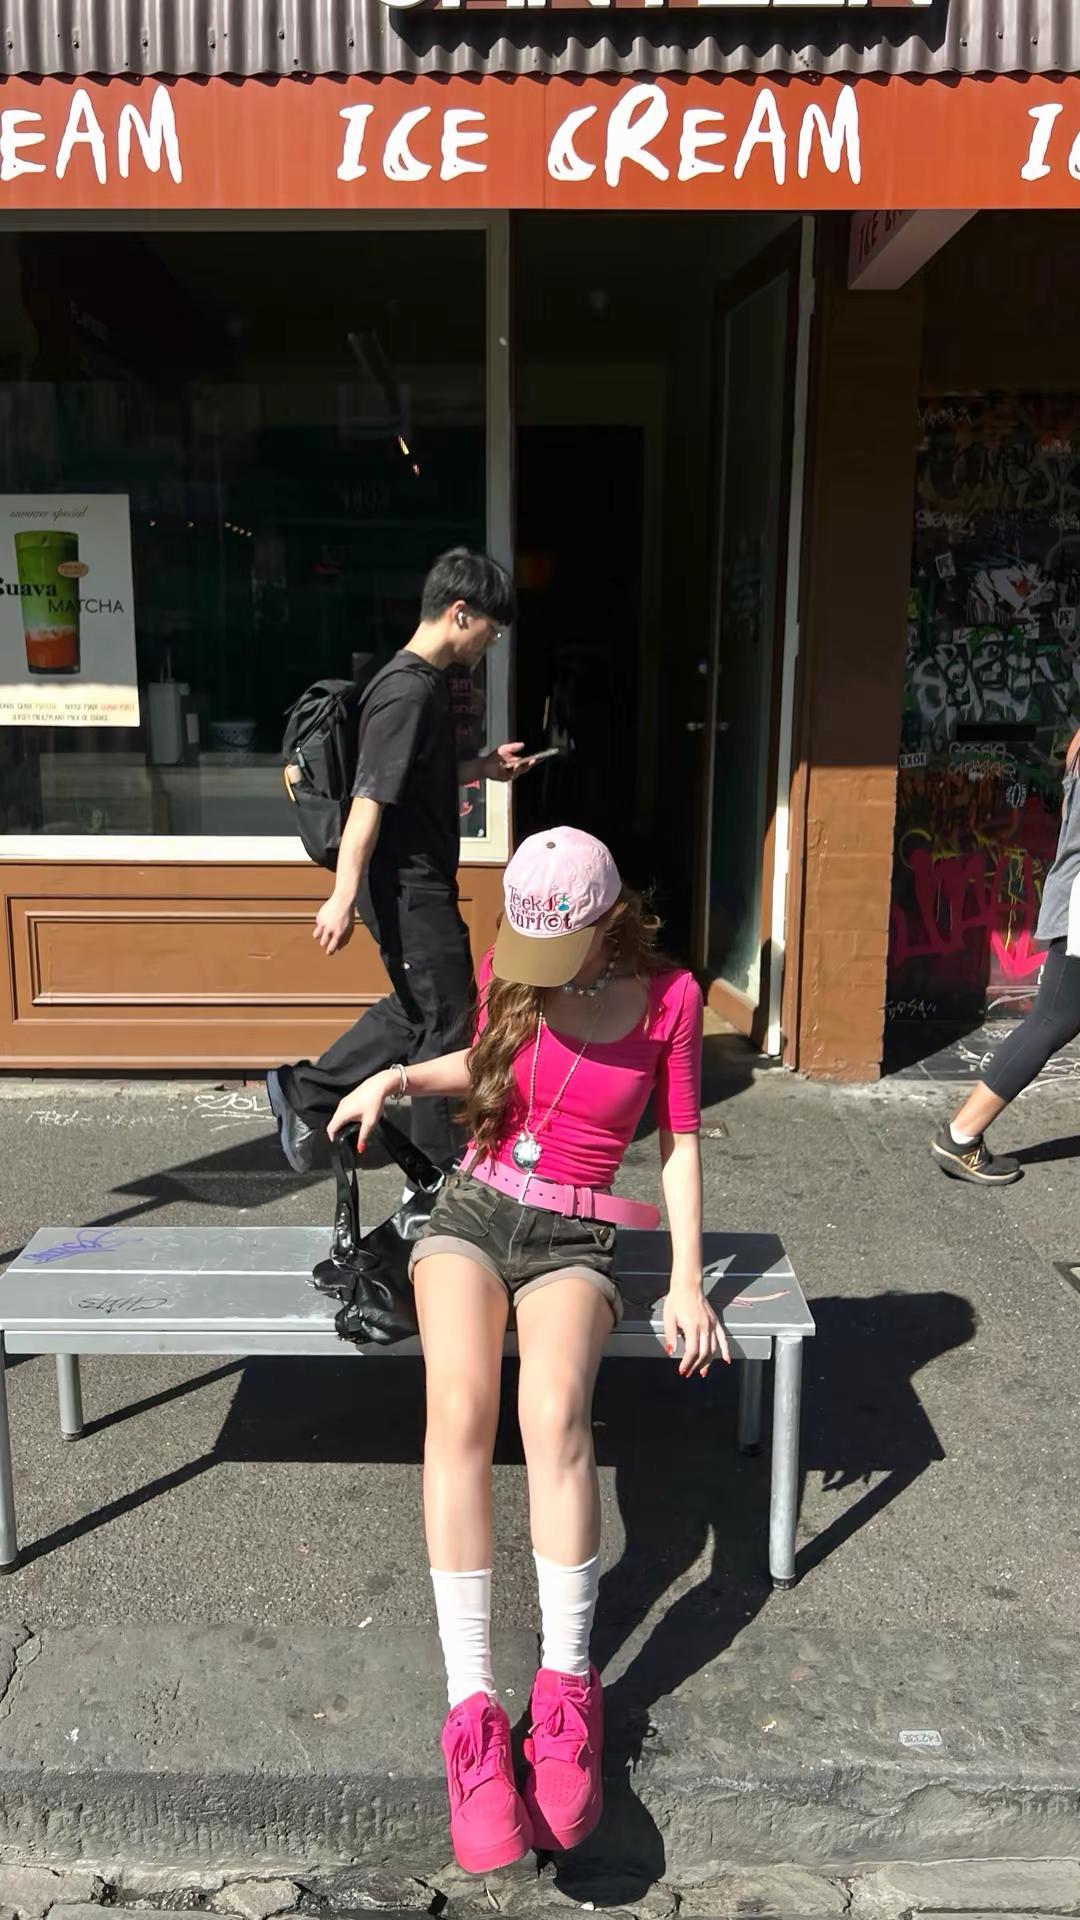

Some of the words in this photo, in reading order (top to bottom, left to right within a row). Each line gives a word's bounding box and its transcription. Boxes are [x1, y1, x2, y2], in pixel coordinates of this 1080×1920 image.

[336, 103, 489, 182] ICE
[547, 83, 861, 187] CREAM
[9, 510, 48, 519] summer
[52, 505, 89, 522] special
[48, 599, 124, 614] MATCHA
